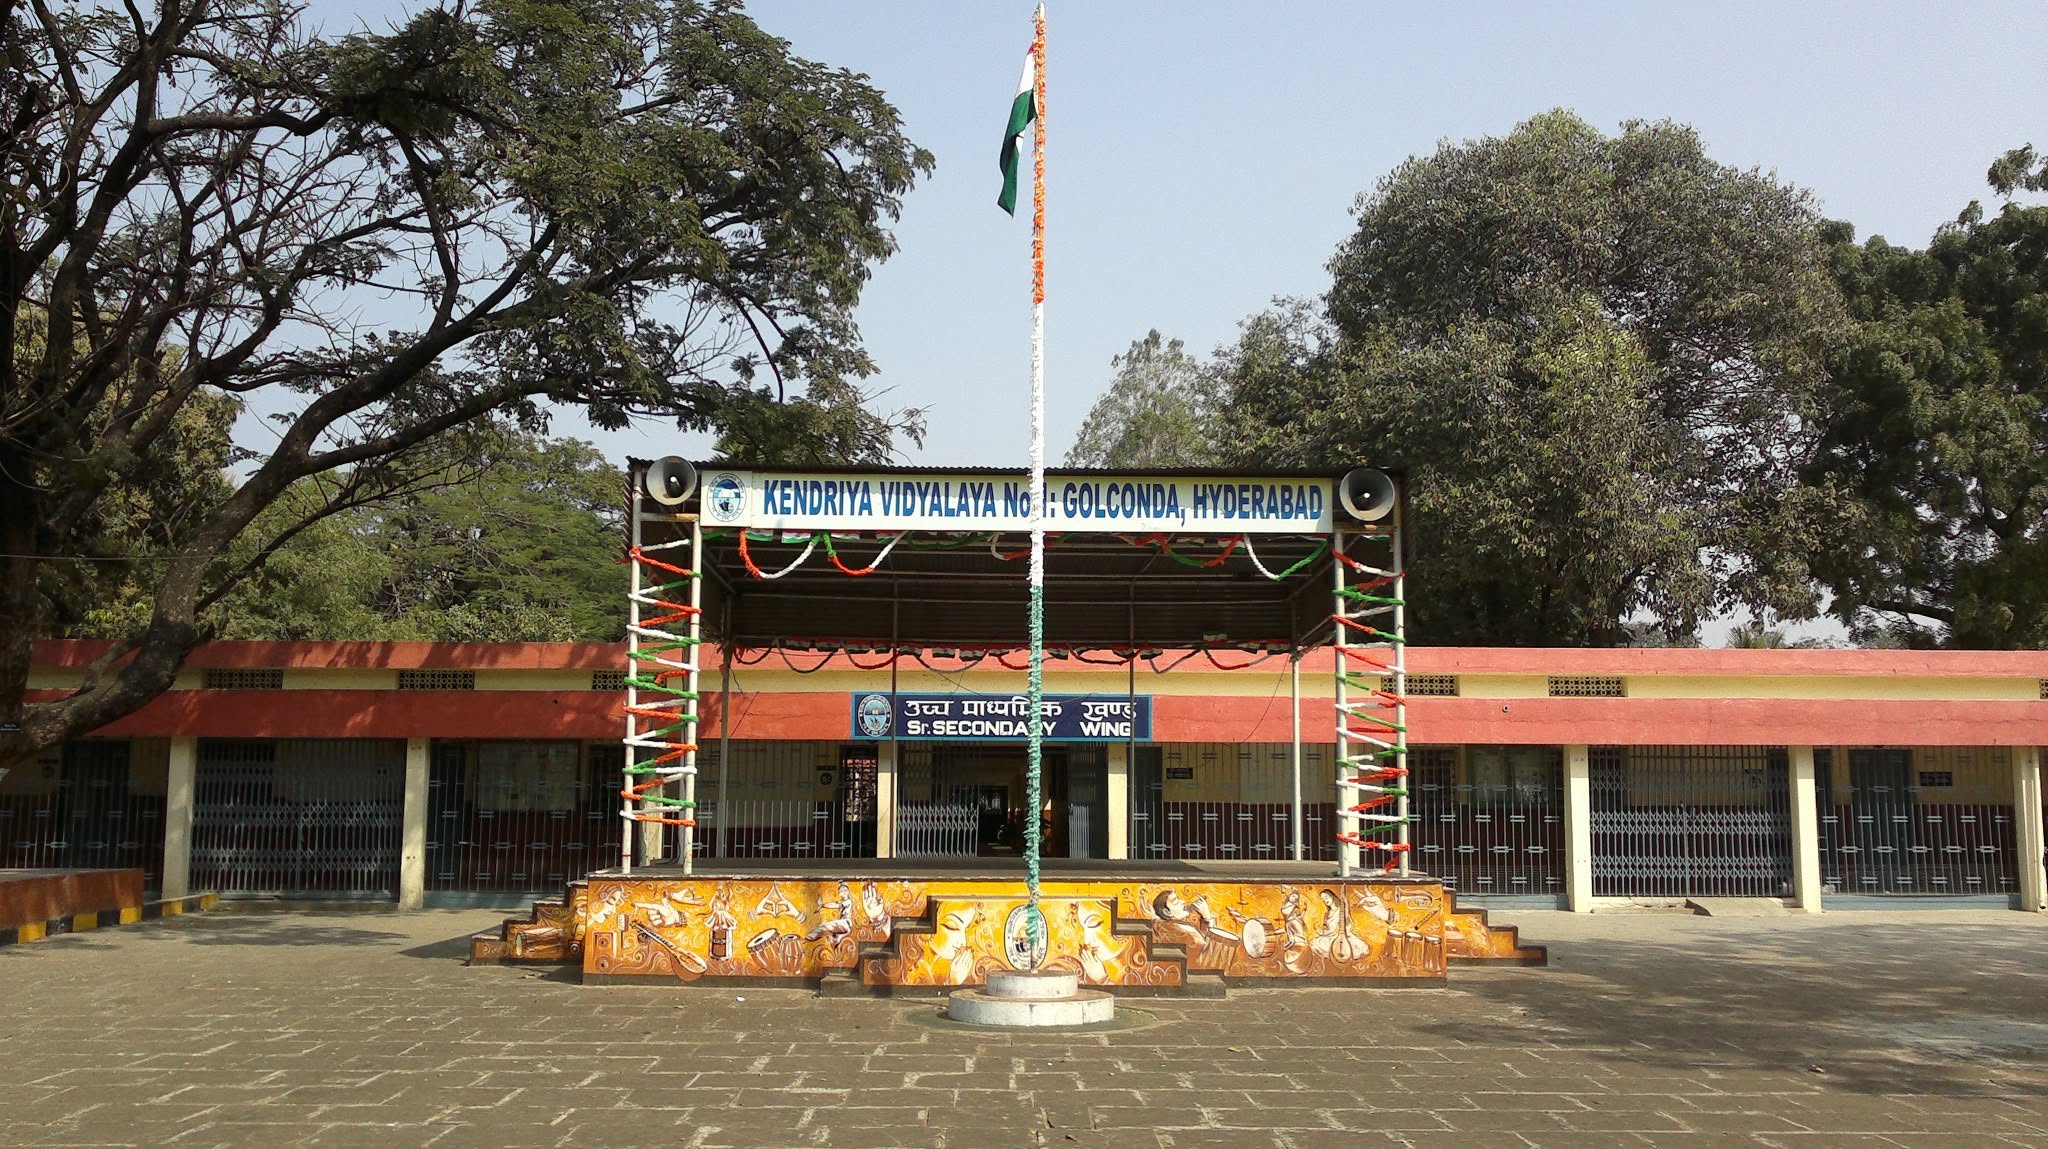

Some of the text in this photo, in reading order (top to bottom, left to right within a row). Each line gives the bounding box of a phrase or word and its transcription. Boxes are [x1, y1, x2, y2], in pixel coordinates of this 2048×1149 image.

[763, 480, 873, 516] KENDRIYA
[880, 481, 997, 518] VIDYALAYA
[1063, 482, 1186, 528] GOLCONDA,
[1193, 484, 1323, 520] HYDERABAD
[904, 700, 955, 717] उच्च
[1081, 701, 1137, 722] खण्ड
[1079, 721, 1132, 738] WING
